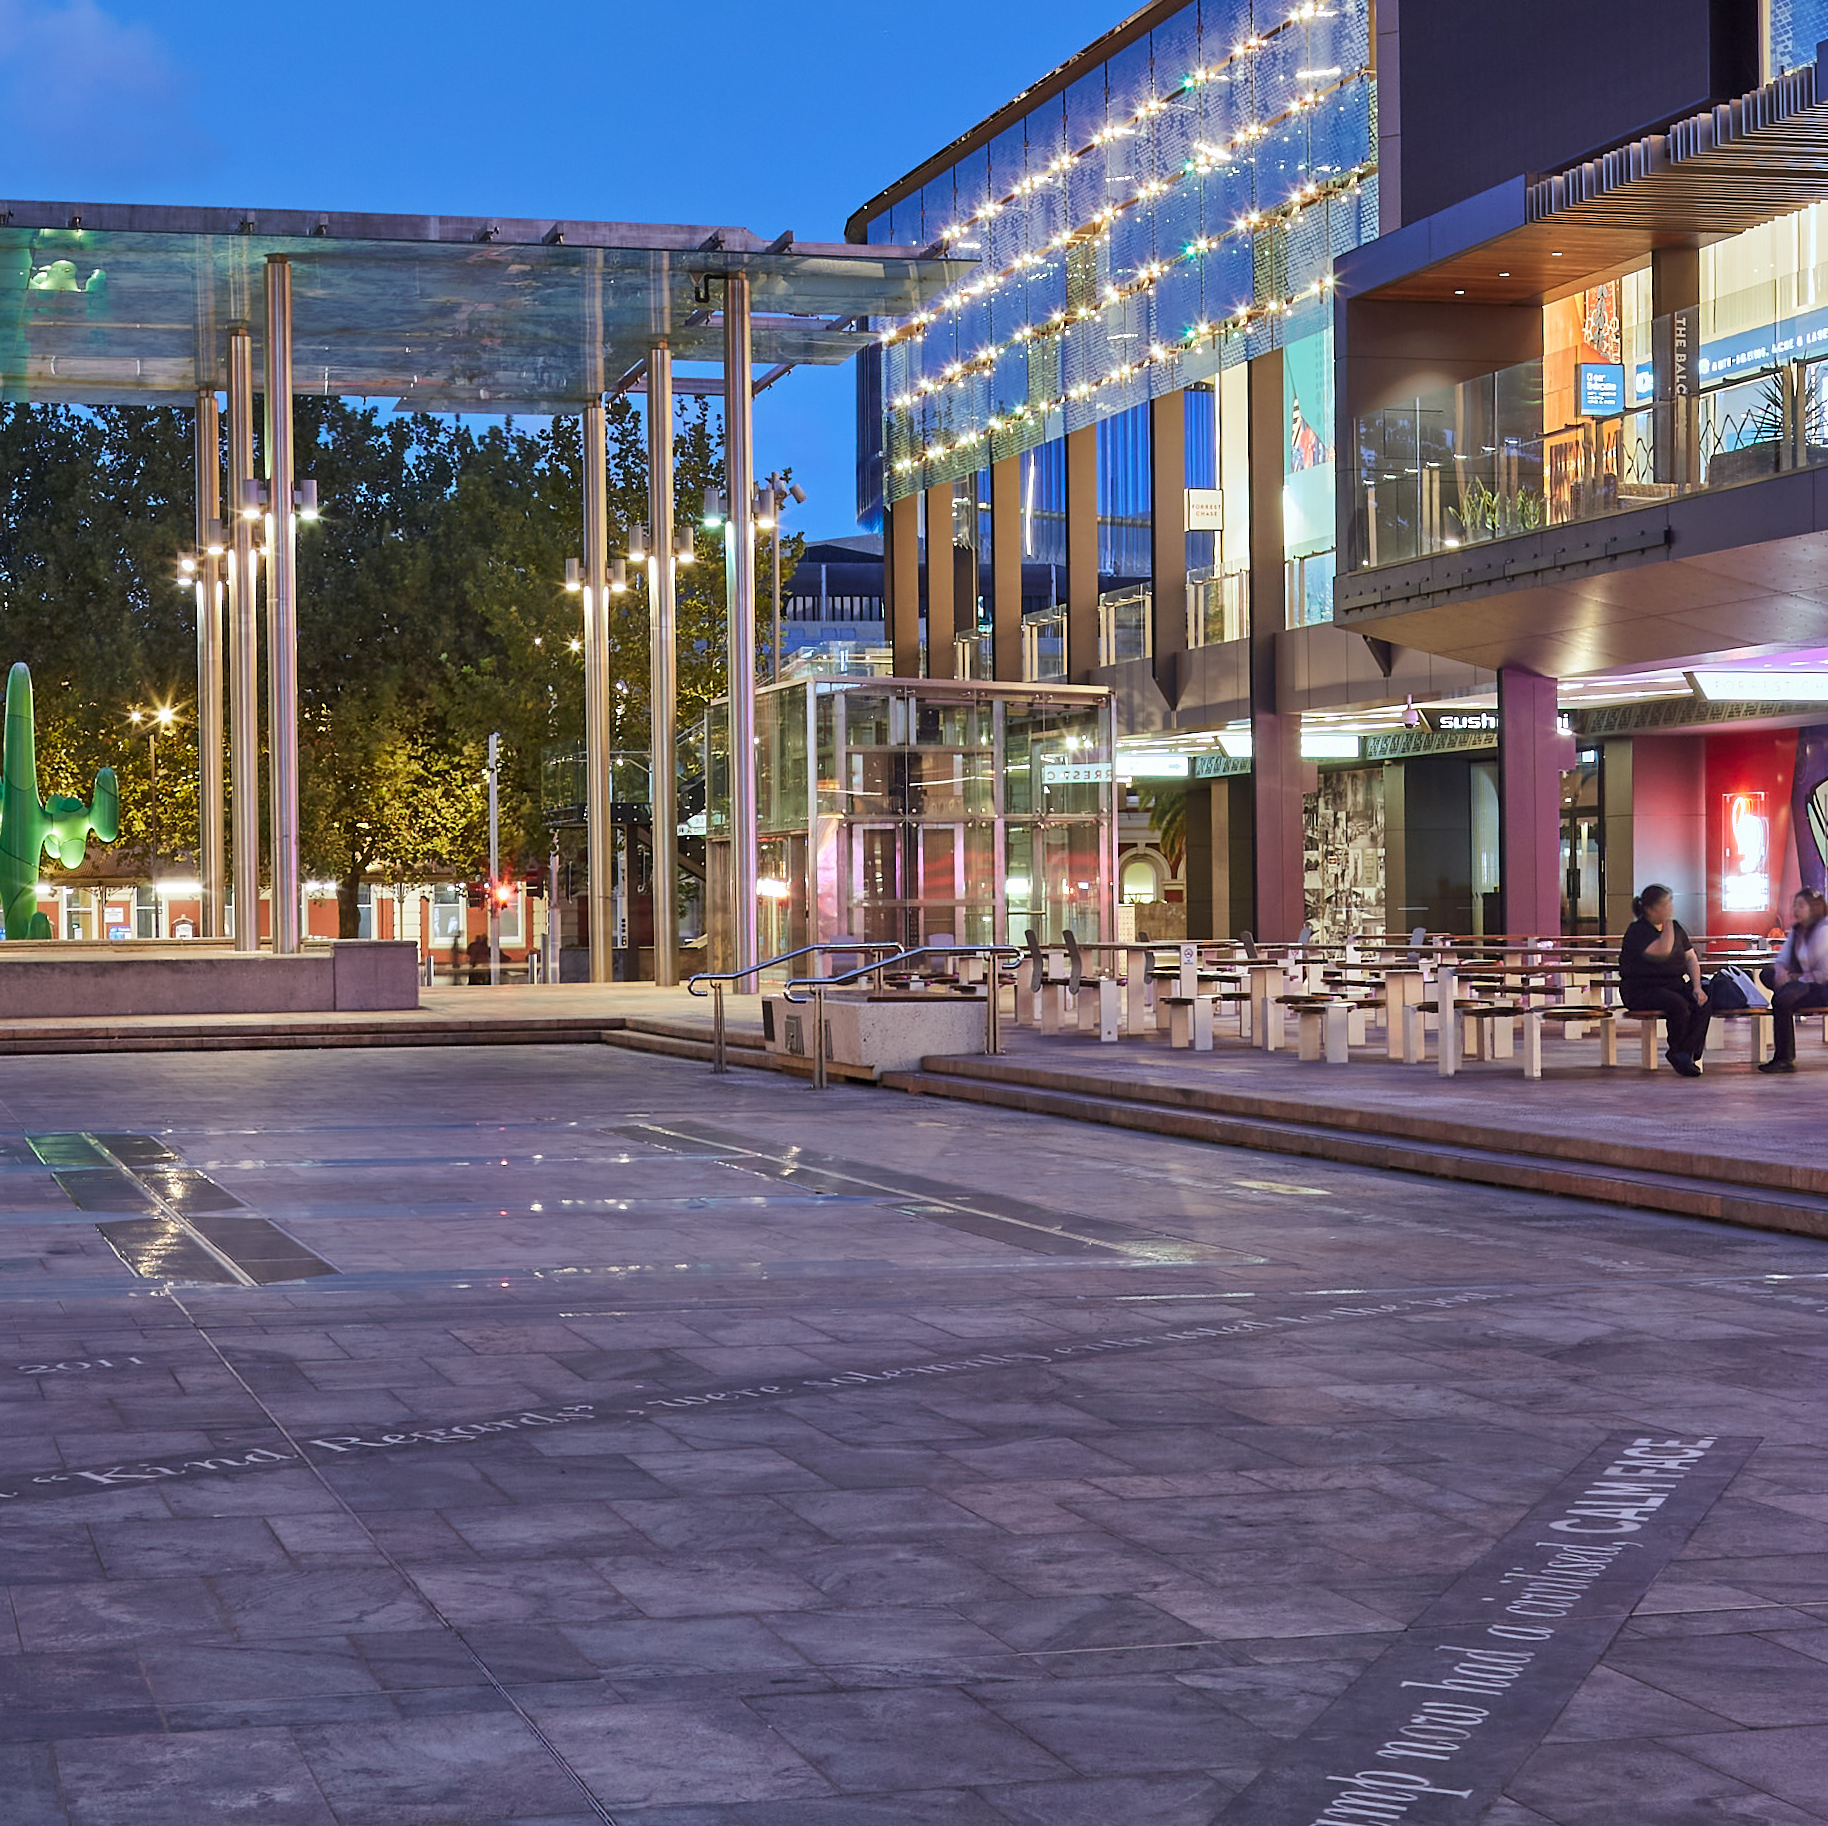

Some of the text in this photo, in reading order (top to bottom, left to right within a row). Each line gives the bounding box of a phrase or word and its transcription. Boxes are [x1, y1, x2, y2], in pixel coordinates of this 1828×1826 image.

[1676, 317, 1688, 395] THE BALC
[15, 1356, 145, 1374] 2011
[1602, 1435, 1719, 1479] FACE.
[1549, 1481, 1677, 1534] CALM
[1486, 1623, 1556, 1641] a
[1399, 1644, 1535, 1696] had
[1376, 1700, 1490, 1761] now
